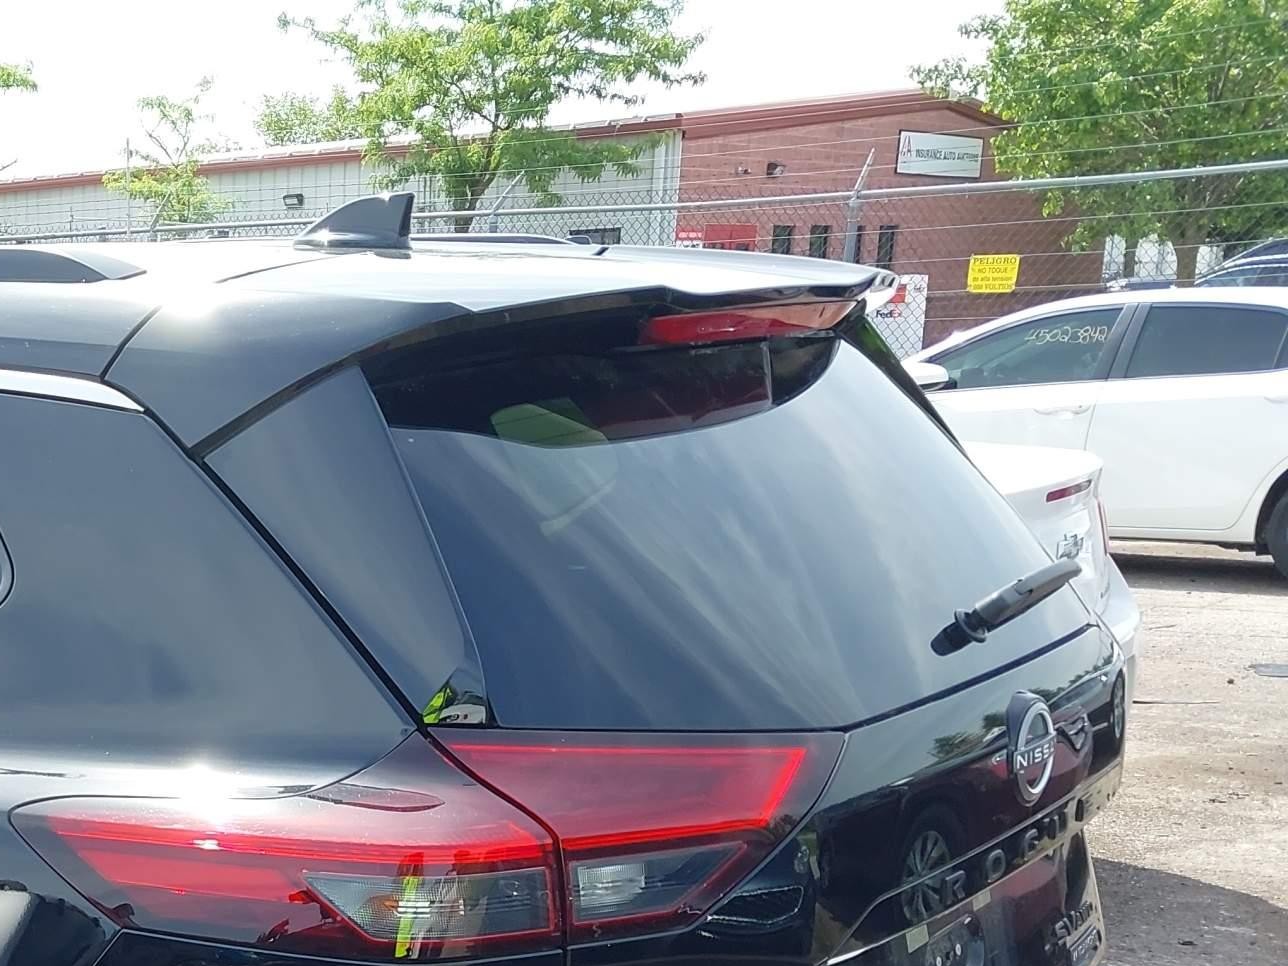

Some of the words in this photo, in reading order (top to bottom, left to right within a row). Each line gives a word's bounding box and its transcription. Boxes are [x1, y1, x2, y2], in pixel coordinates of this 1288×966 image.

[915, 148, 943, 160] INSURANCE
[943, 151, 956, 160] AUTO
[973, 256, 1017, 265] PELIGRO
[1024, 325, 1108, 345] 45023842
[1016, 742, 1054, 769] NISS
